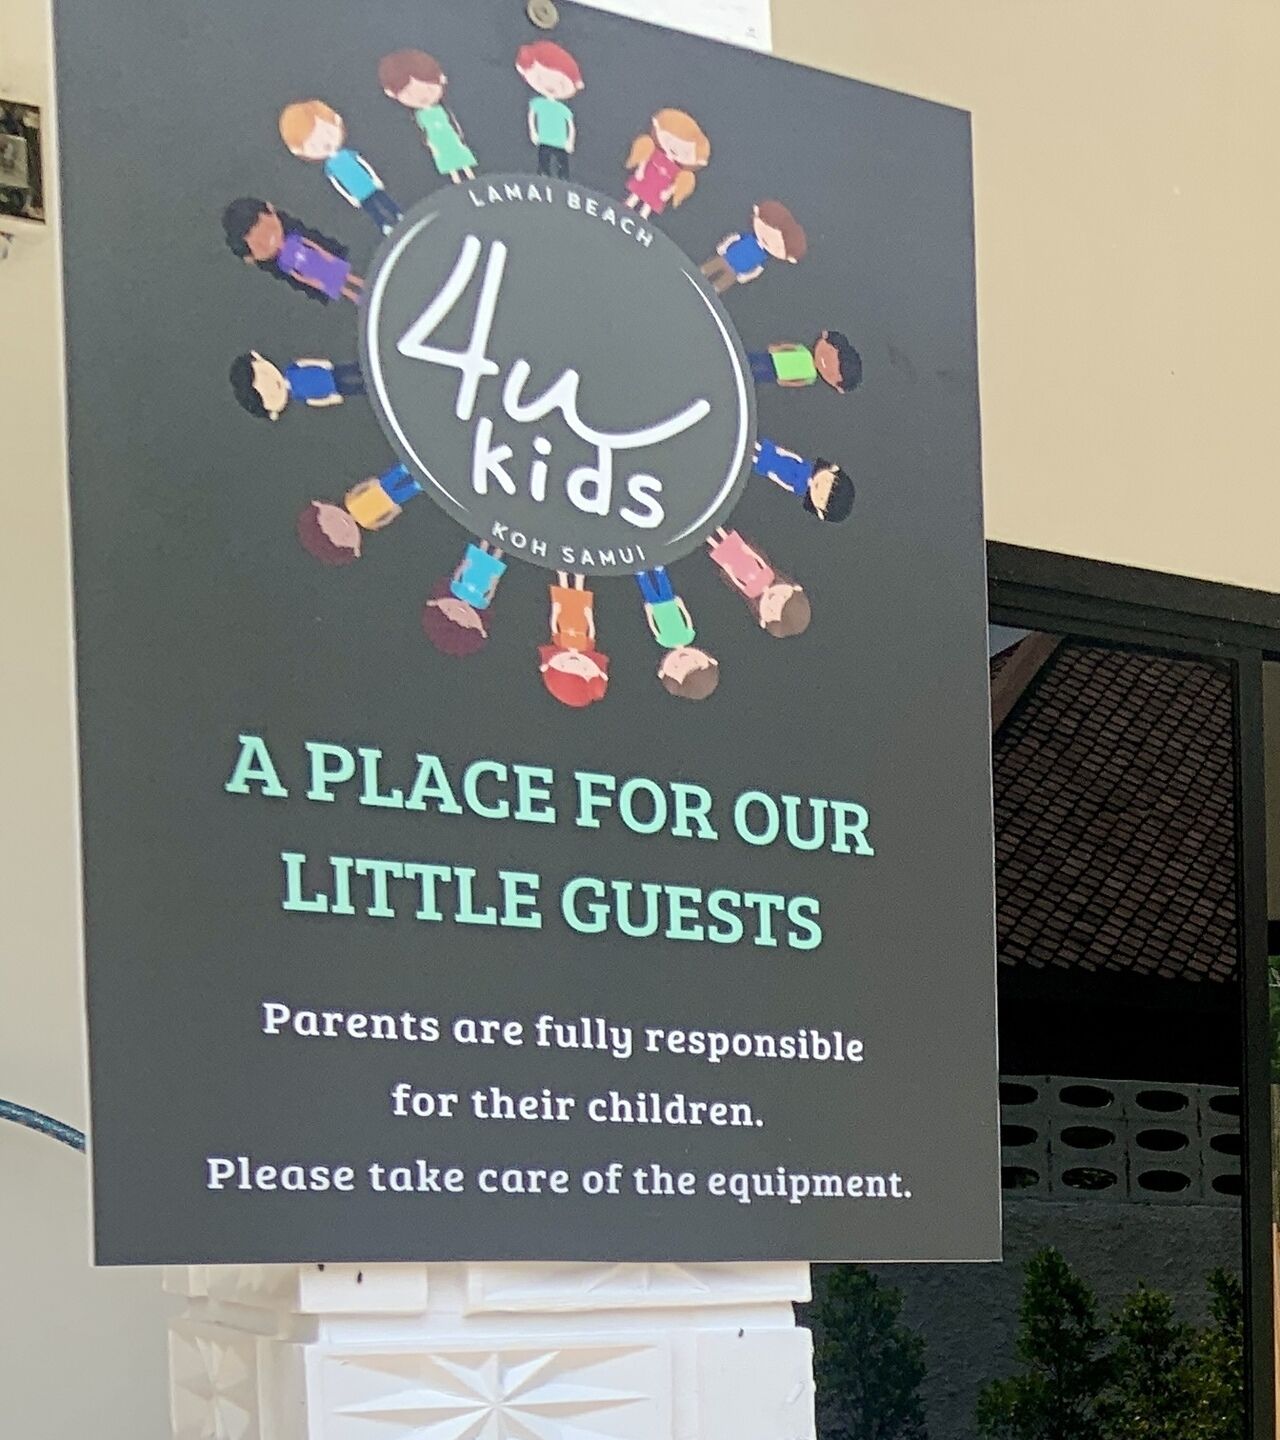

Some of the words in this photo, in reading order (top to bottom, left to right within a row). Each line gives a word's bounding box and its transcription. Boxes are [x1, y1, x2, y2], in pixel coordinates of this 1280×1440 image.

[468, 183, 553, 207] LAMAI
[566, 190, 654, 248] BEACH
[472, 417, 665, 529] kids
[489, 520, 548, 558] KOH
[562, 543, 646, 566] SAMUI
[225, 734, 288, 798] A
[305, 741, 556, 824] PLACE
[574, 771, 718, 840] FOR
[734, 790, 875, 856] OUR
[281, 852, 542, 929] LITTLE
[562, 877, 822, 950] GUESTS
[263, 1002, 440, 1042] Parents
[453, 1019, 523, 1046] are
[534, 1014, 632, 1059] fully
[645, 1029, 864, 1063] responsible
[391, 1083, 459, 1117] for
[471, 1086, 575, 1121] their
[588, 1090, 764, 1127] children.
[206, 1156, 355, 1191] Please
[368, 1159, 464, 1192] take
[478, 1168, 569, 1194] care
[582, 1163, 623, 1194] of
[633, 1164, 696, 1195] the
[708, 1166, 912, 1204] equipment.
